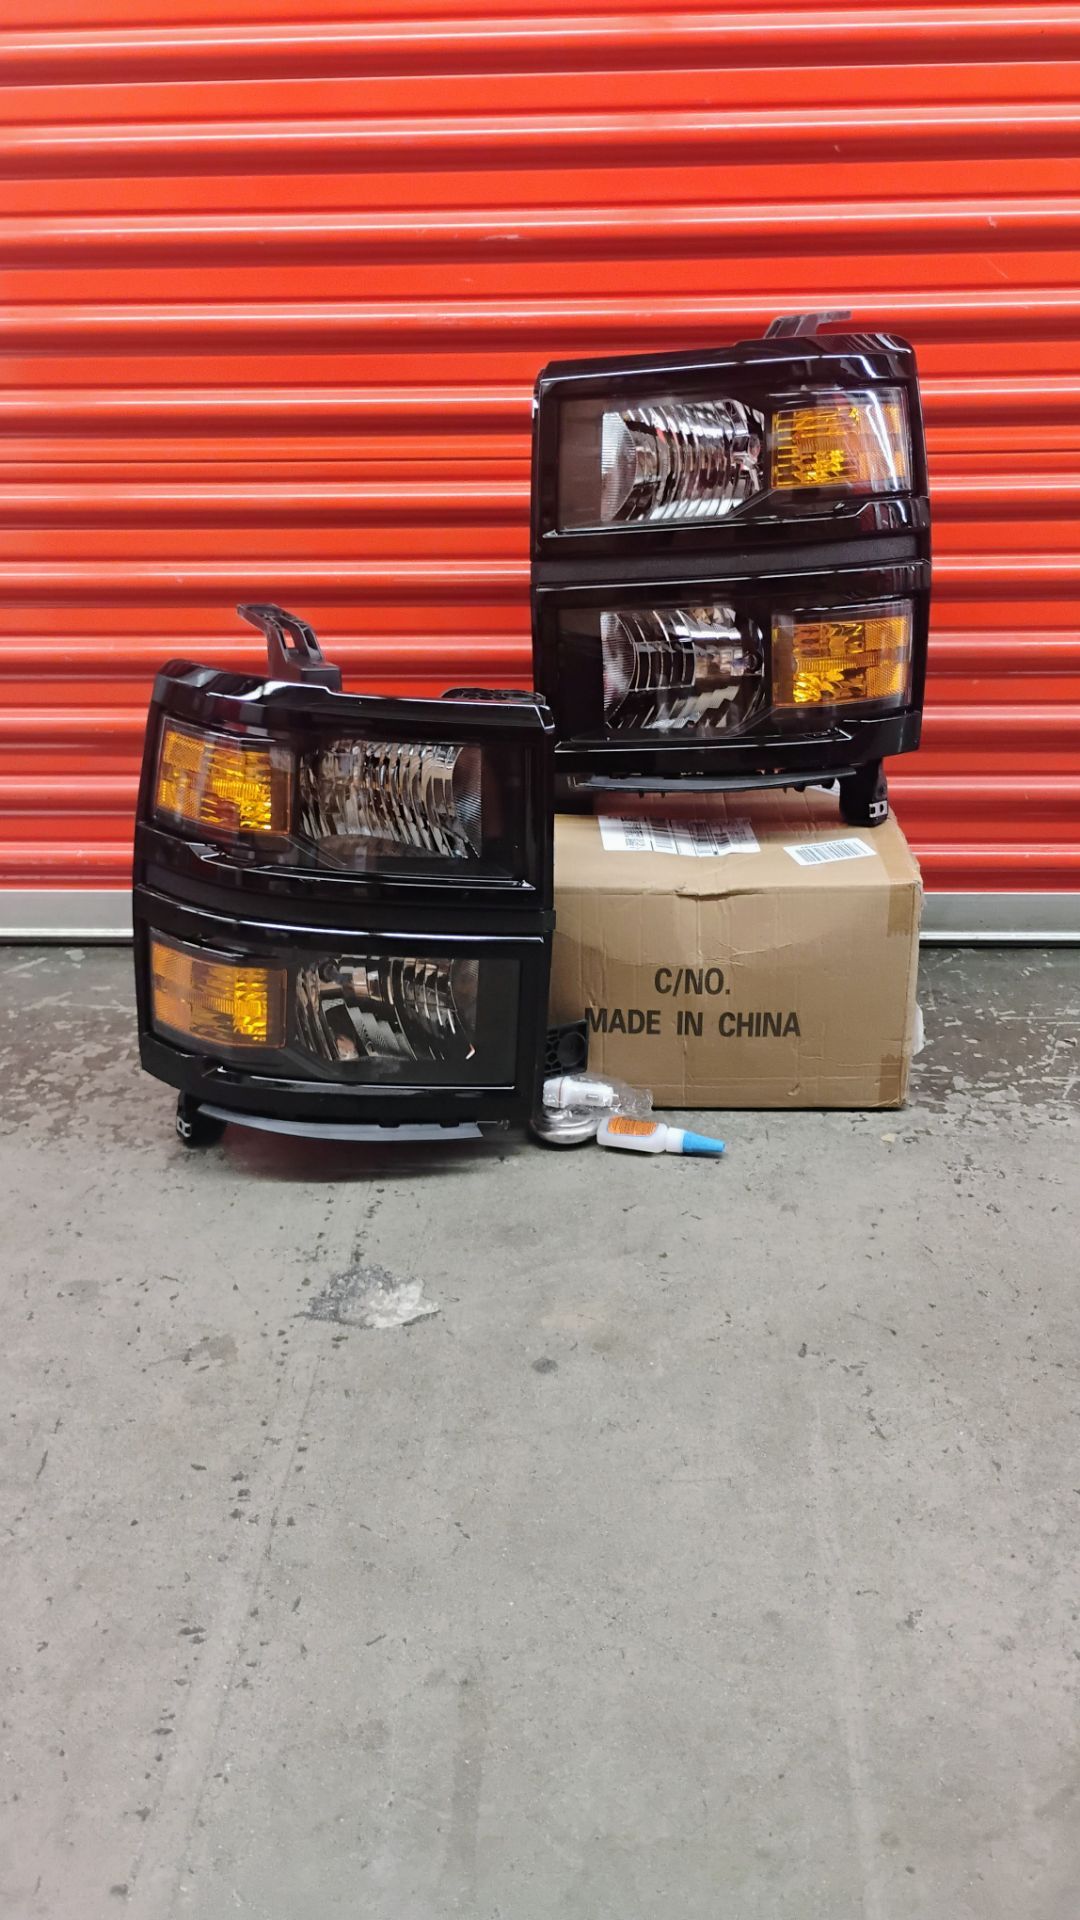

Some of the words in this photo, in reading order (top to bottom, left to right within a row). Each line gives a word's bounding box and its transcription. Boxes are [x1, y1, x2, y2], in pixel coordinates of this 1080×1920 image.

[654, 967, 731, 997] C/NO.
[584, 1007, 661, 1035] MADE
[676, 1010, 704, 1037] IN
[718, 1011, 801, 1038] CHINA
